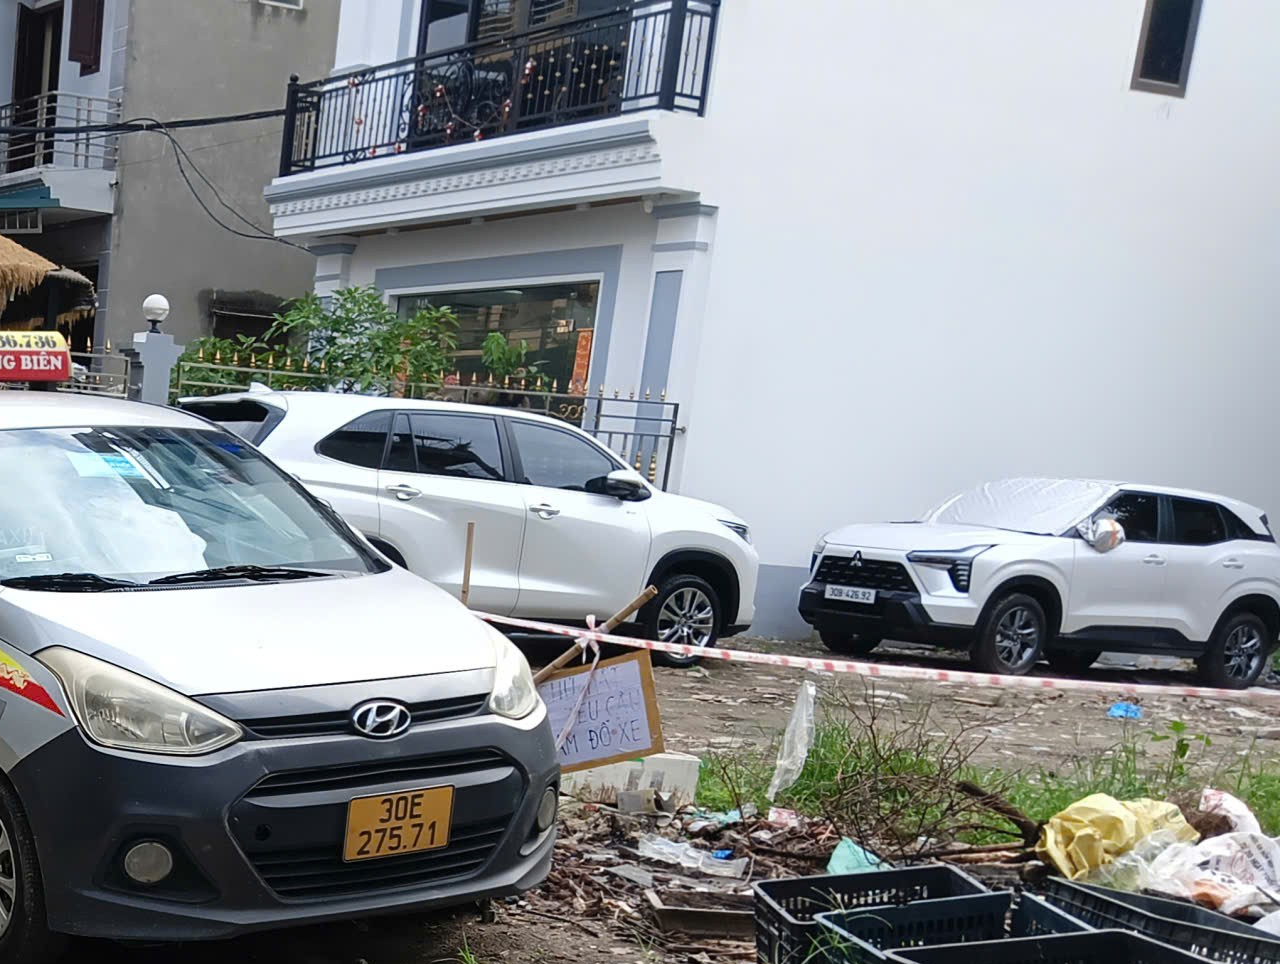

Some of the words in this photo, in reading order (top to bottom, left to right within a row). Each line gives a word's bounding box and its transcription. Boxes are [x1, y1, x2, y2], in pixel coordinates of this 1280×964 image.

[21, 351, 63, 371] BIÊN
[618, 718, 642, 745] XE
[378, 793, 424, 824] 30E
[356, 820, 437, 856] 275.71
